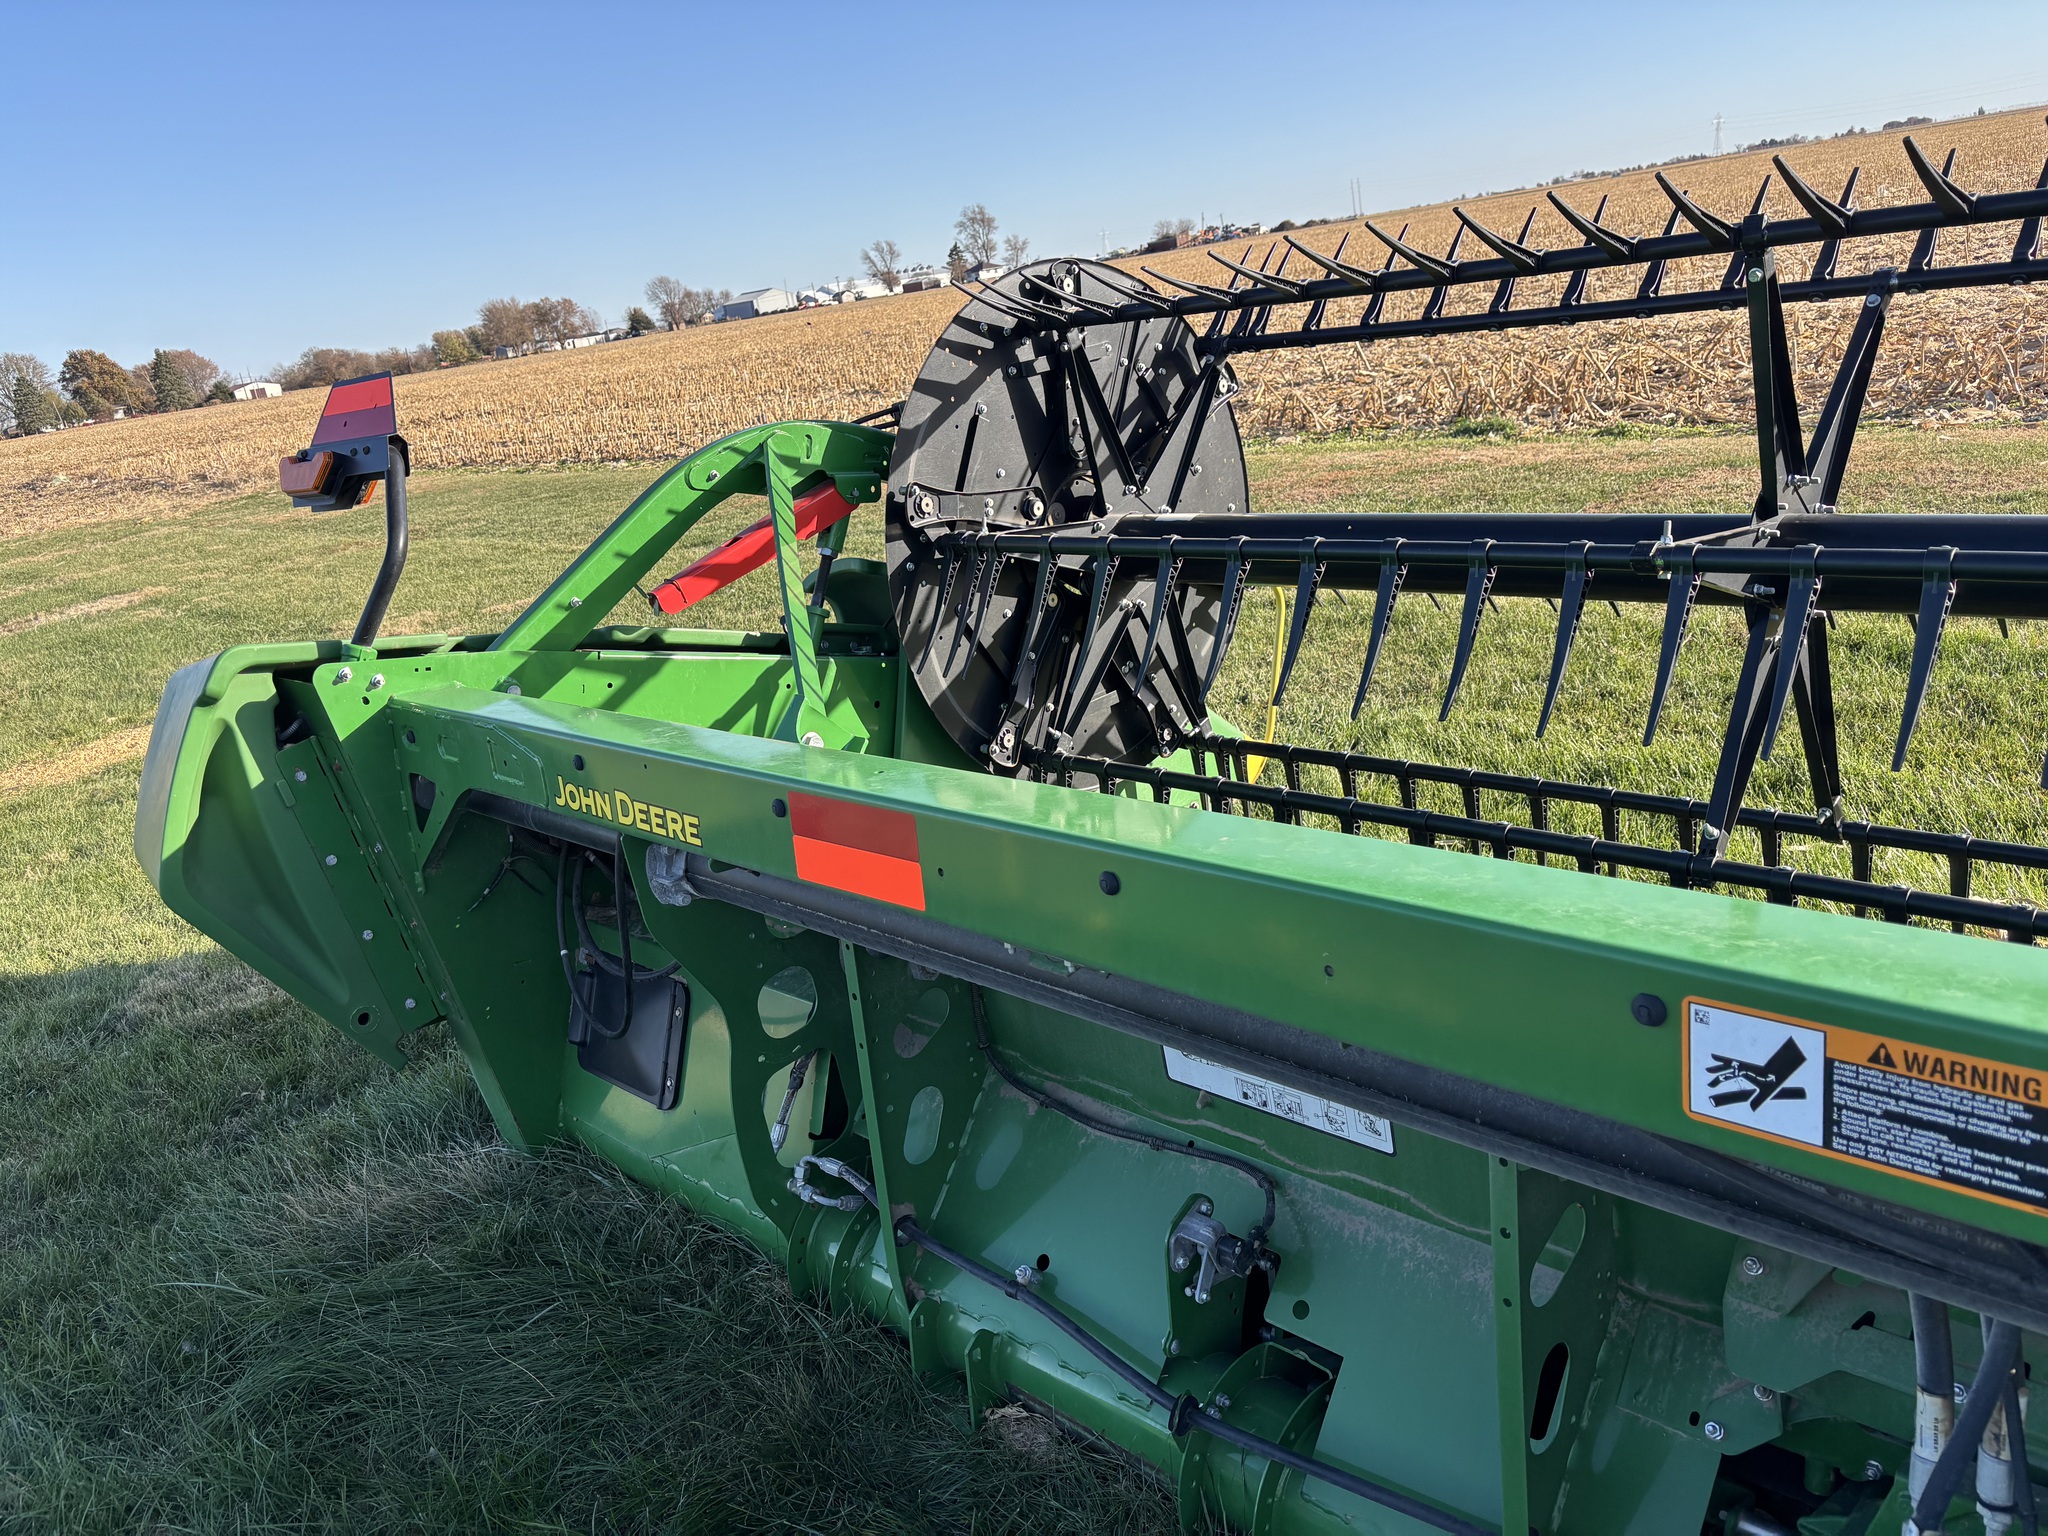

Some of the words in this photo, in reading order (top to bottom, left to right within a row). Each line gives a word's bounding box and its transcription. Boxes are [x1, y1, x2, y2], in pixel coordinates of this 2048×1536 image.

[555, 775, 613, 822] JOHN
[614, 789, 703, 847] DEERE
[1833, 1074, 1867, 1088] pressure
[1869, 1084, 1888, 1092] even
[1890, 1088, 1911, 1097] when
[1913, 1094, 1950, 1107] detached
[1952, 1102, 1971, 1112] from
[1973, 1107, 2012, 1122] combine.
[1834, 1060, 1856, 1071] Avoid
[1858, 1067, 1883, 1079] bodily
[1885, 1073, 1908, 1085] injury
[1911, 1079, 1931, 1089] from
[1933, 1083, 1972, 1099] hydraulic
[1975, 1094, 1986, 1102] oil
[1988, 1097, 2005, 1106] and
[2007, 1102, 2023, 1112] gas
[1834, 1067, 1856, 1078] under
[1858, 1074, 1897, 1089] pressure.
[1900, 1083, 1939, 1098] Hydraulic
[1941, 1092, 1960, 1102] float
[1962, 1098, 1994, 1112] system
[2007, 1108, 2032, 1120] under
[1904, 1050, 2041, 1102] WARNING
[1833, 1084, 1857, 1095] Before
[1859, 1091, 1896, 1106] removing,
[1969, 1117, 2006, 1133] changing
[2008, 1127, 2022, 1137] any
[2025, 1130, 2040, 1140] flex
[1833, 1091, 1857, 1102] draper
[1859, 1097, 1875, 1106] float
[1877, 1102, 1905, 1114] system
[1906, 1109, 1955, 1126] components
[1967, 1124, 2018, 1142] accumulator
[2019, 1137, 2030, 1145] do
[1841, 1109, 1866, 1120] Attach
[1868, 1116, 1900, 1130] platform
[1912, 1127, 1950, 1142] combine.
[1846, 1100, 1883, 1116] following:
[1832, 1143, 1846, 1151] See
[1848, 1147, 1865, 1157] your
[1867, 1152, 1887, 1162] John
[1889, 1158, 1912, 1169] Deere
[1913, 1164, 1940, 1177] dealer.
[1833, 1136, 1846, 1145] Use
[1848, 1140, 1865, 1150] only
[1867, 1145, 1884, 1154] DRY
[1886, 1150, 1929, 1166] NITROGEN
[1944, 1166, 1989, 1184] recharging
[1991, 1178, 2046, 1198] accumulator.
[1841, 1116, 1866, 1127] Sound
[1890, 1128, 1908, 1138] start
[1910, 1134, 1937, 1146] engine
[1939, 1141, 1955, 1150] and
[1957, 1147, 1971, 1155] use
[1974, 1150, 2002, 1162] header
[2004, 1157, 2024, 1168] float
[1841, 1122, 1869, 1134] control
[1880, 1132, 1894, 1140] cab
[1906, 1139, 1932, 1150] relieve
[1934, 1147, 1972, 1162] pressure.
[1841, 1129, 1858, 1139] Stop
[1891, 1142, 1920, 1154] remove
[1941, 1156, 1957, 1164] and
[1973, 1164, 1992, 1174] park
[1994, 1169, 2020, 1181] brake.
